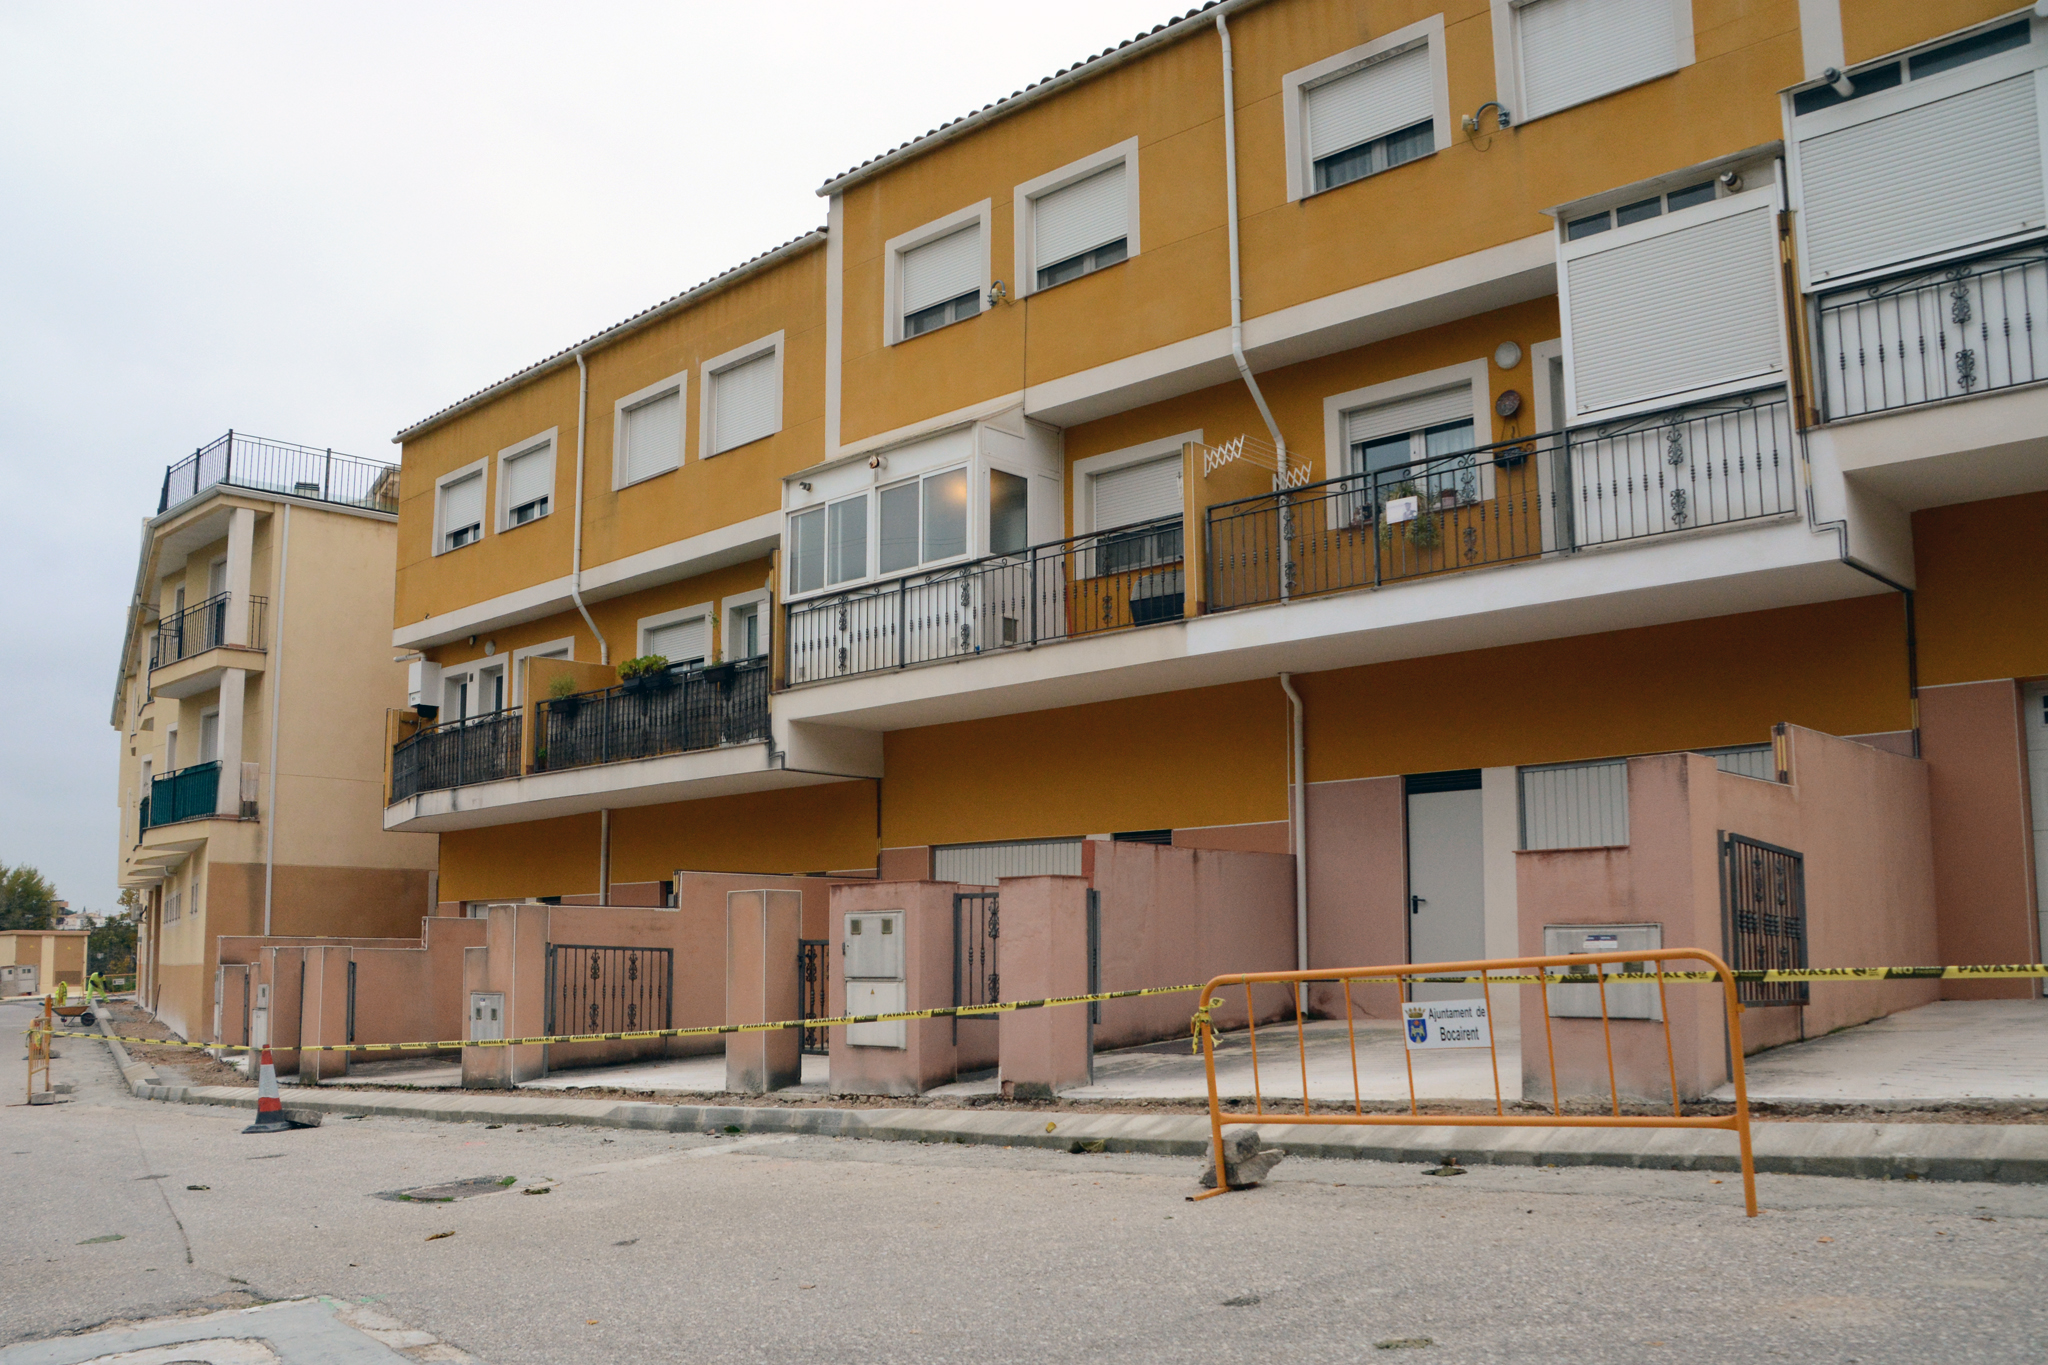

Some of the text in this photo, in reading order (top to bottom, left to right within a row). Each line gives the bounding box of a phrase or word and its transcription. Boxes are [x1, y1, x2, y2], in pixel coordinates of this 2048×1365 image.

[1777, 968, 1849, 976] PAVASAL
[1891, 966, 1914, 975] NO
[1957, 965, 2039, 973] PAVASAL
[1616, 971, 1681, 979] PAVAAL
[1428, 1006, 1486, 1022] Ajuntament de
[1440, 1026, 1480, 1041] Bocairent
